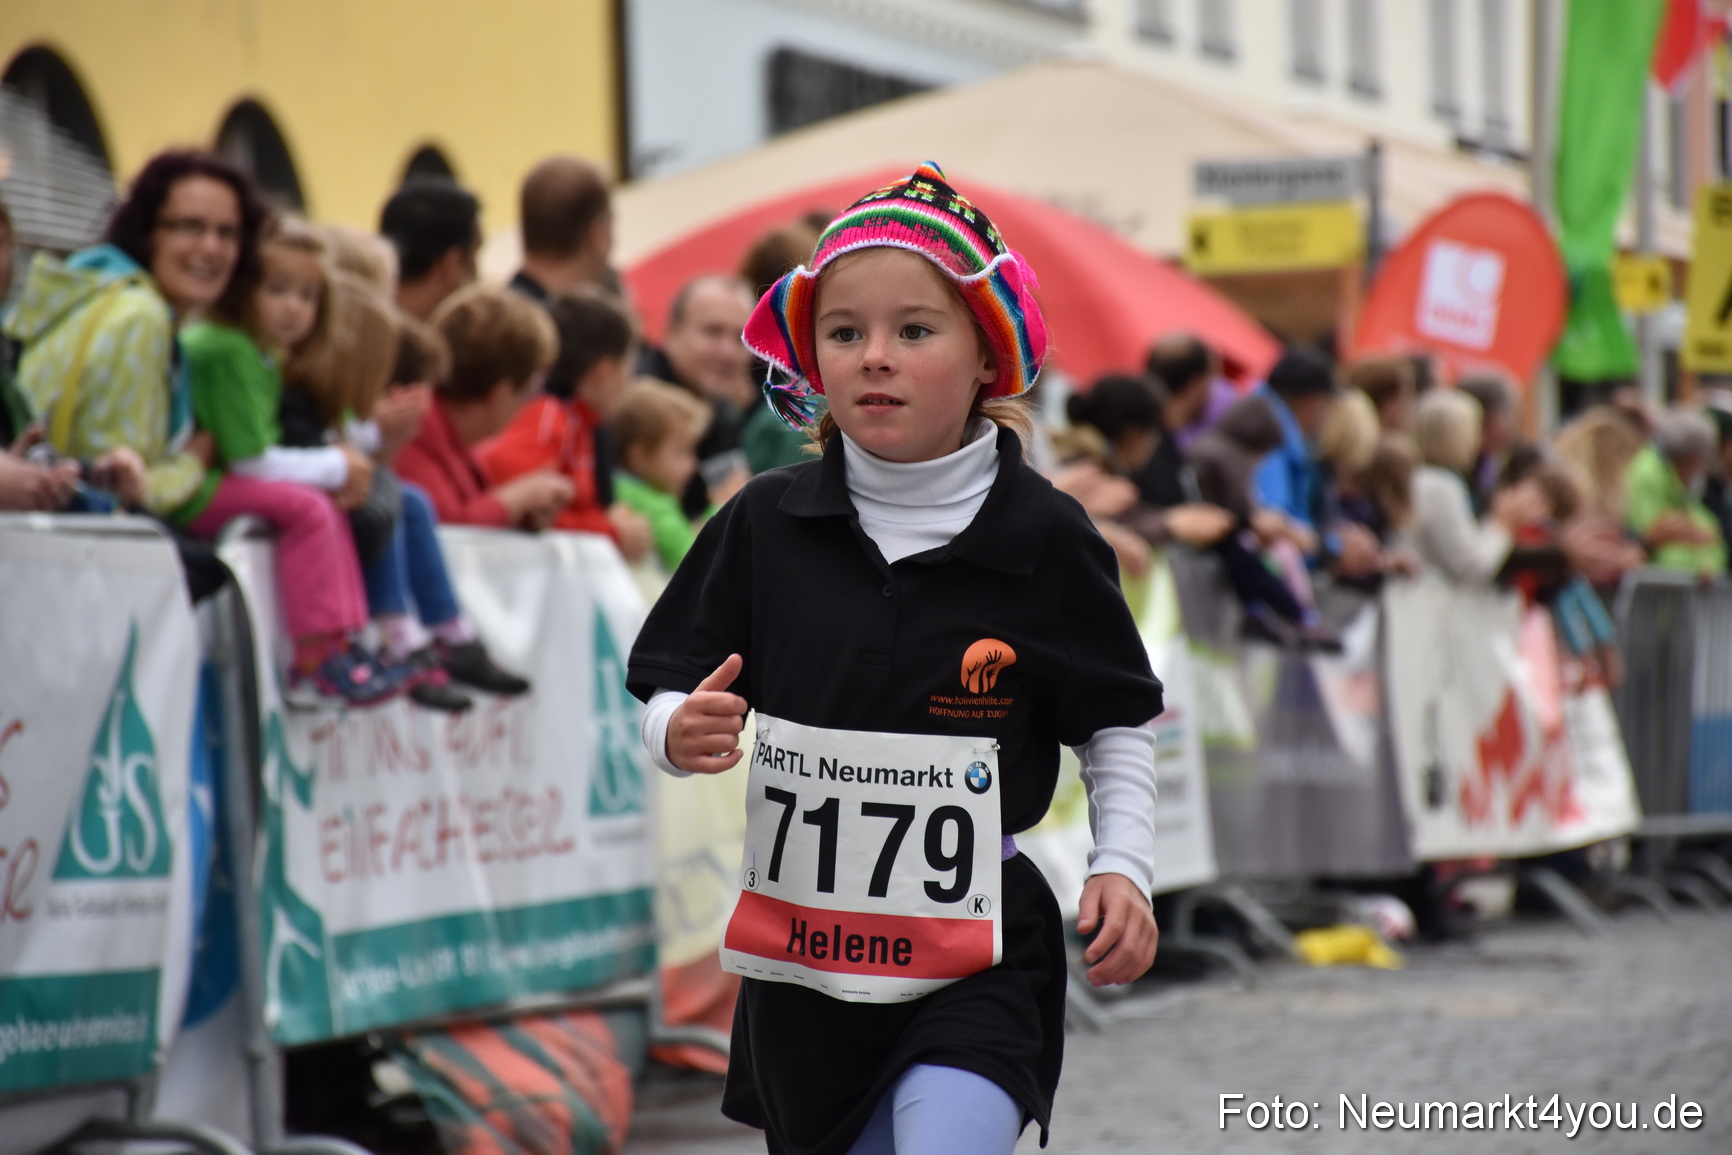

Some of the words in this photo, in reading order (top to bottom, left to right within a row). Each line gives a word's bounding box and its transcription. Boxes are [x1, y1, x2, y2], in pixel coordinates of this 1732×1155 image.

[929, 706, 970, 719] HOFFNUNG
[971, 710, 985, 719] AUF
[756, 741, 812, 778] PARTL
[818, 756, 954, 789] Neumarkt
[764, 784, 975, 904] 7179
[747, 871, 757, 888] 3
[973, 897, 985, 914] K
[786, 916, 914, 967] Helene
